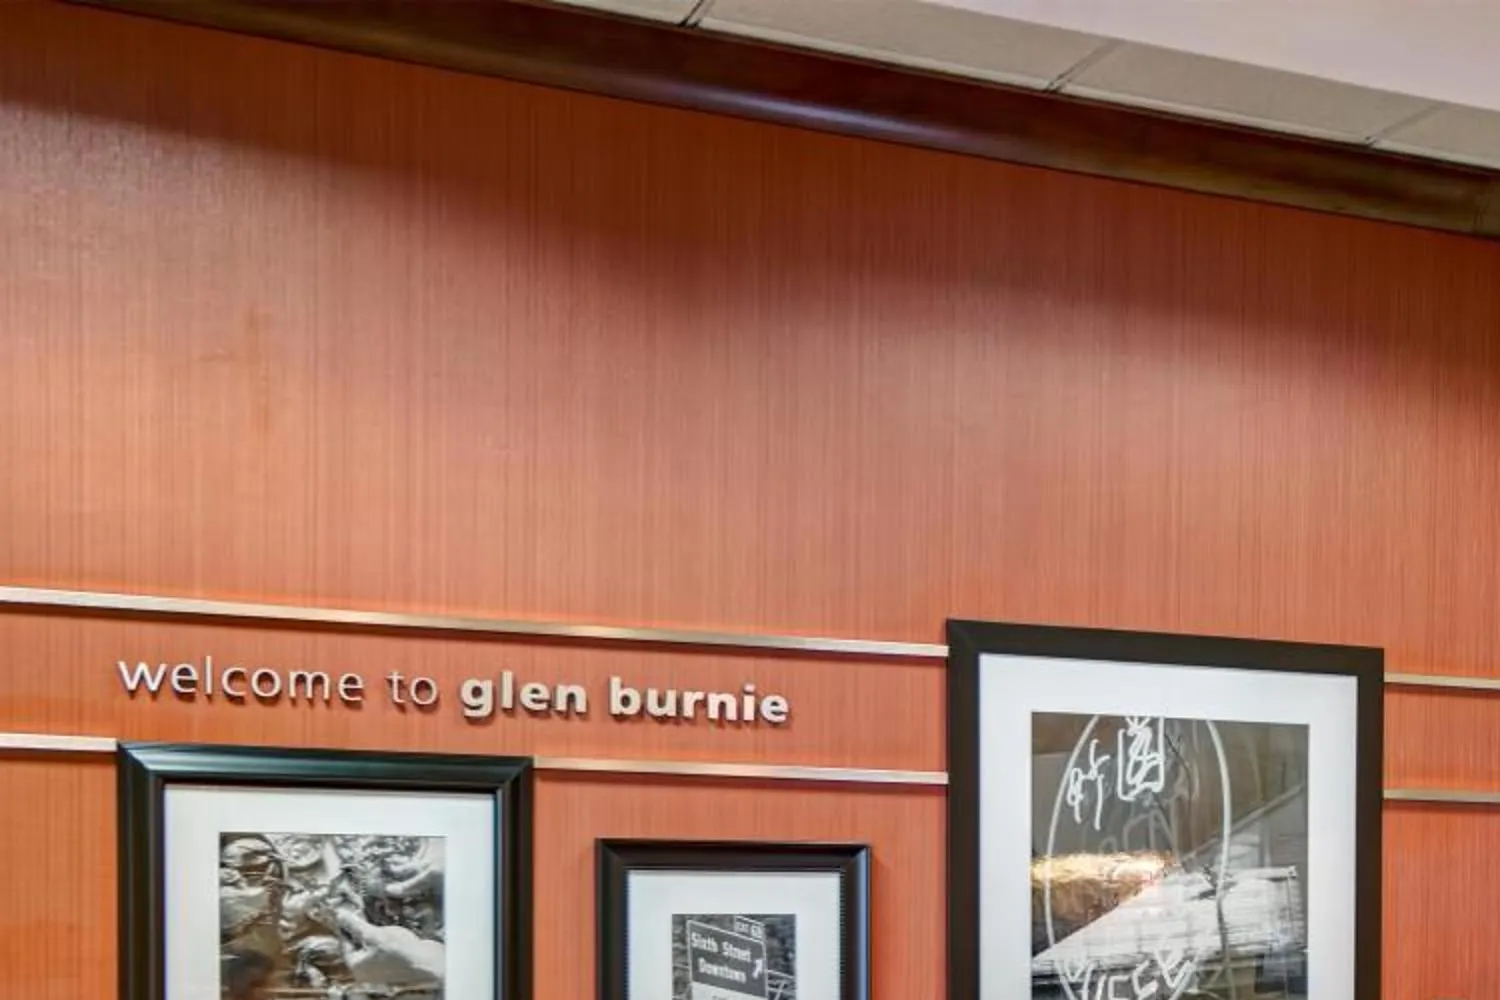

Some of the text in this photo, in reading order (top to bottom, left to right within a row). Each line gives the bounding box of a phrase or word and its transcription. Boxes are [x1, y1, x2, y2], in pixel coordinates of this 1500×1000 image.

[117, 655, 790, 722] welcome to glen burnie
